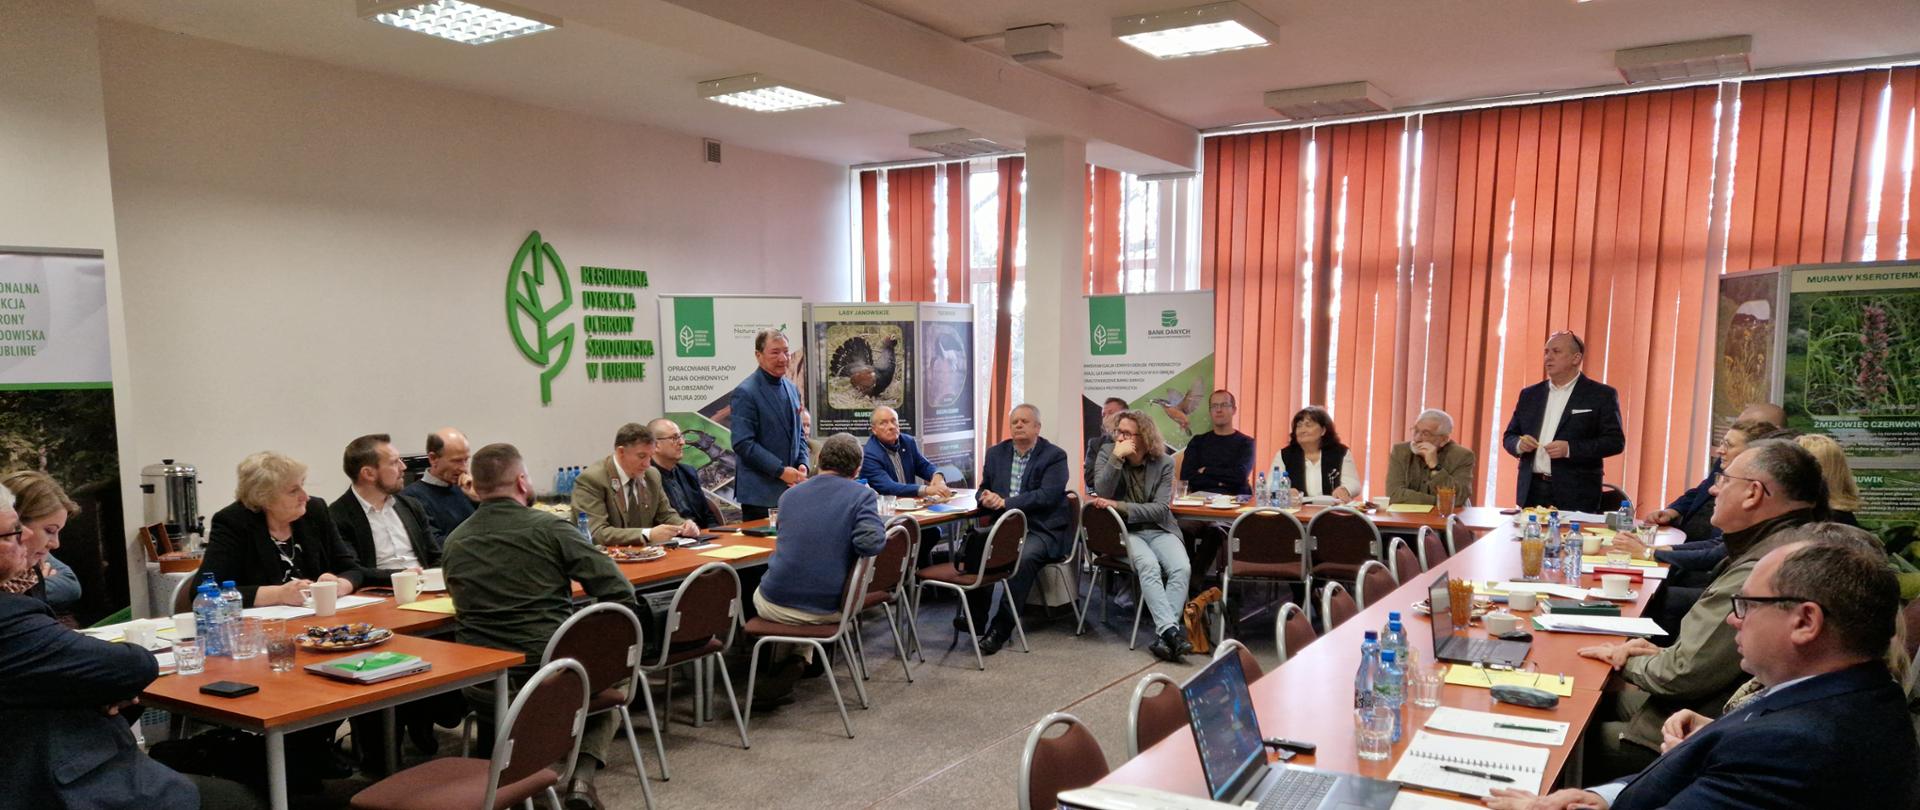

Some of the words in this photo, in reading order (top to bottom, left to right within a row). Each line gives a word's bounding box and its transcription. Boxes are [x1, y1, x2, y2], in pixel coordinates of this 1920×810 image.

[580, 266, 648, 287] REGIONALNA
[1807, 275, 1853, 283] MURAWY
[582, 291, 636, 310] DYREKCJA
[583, 315, 634, 333] OCHRONY
[1165, 328, 1191, 336] DANYCH
[585, 335, 655, 357] ŚRODOWISKA
[586, 363, 599, 381] W
[601, 363, 646, 381] LUBLINIE
